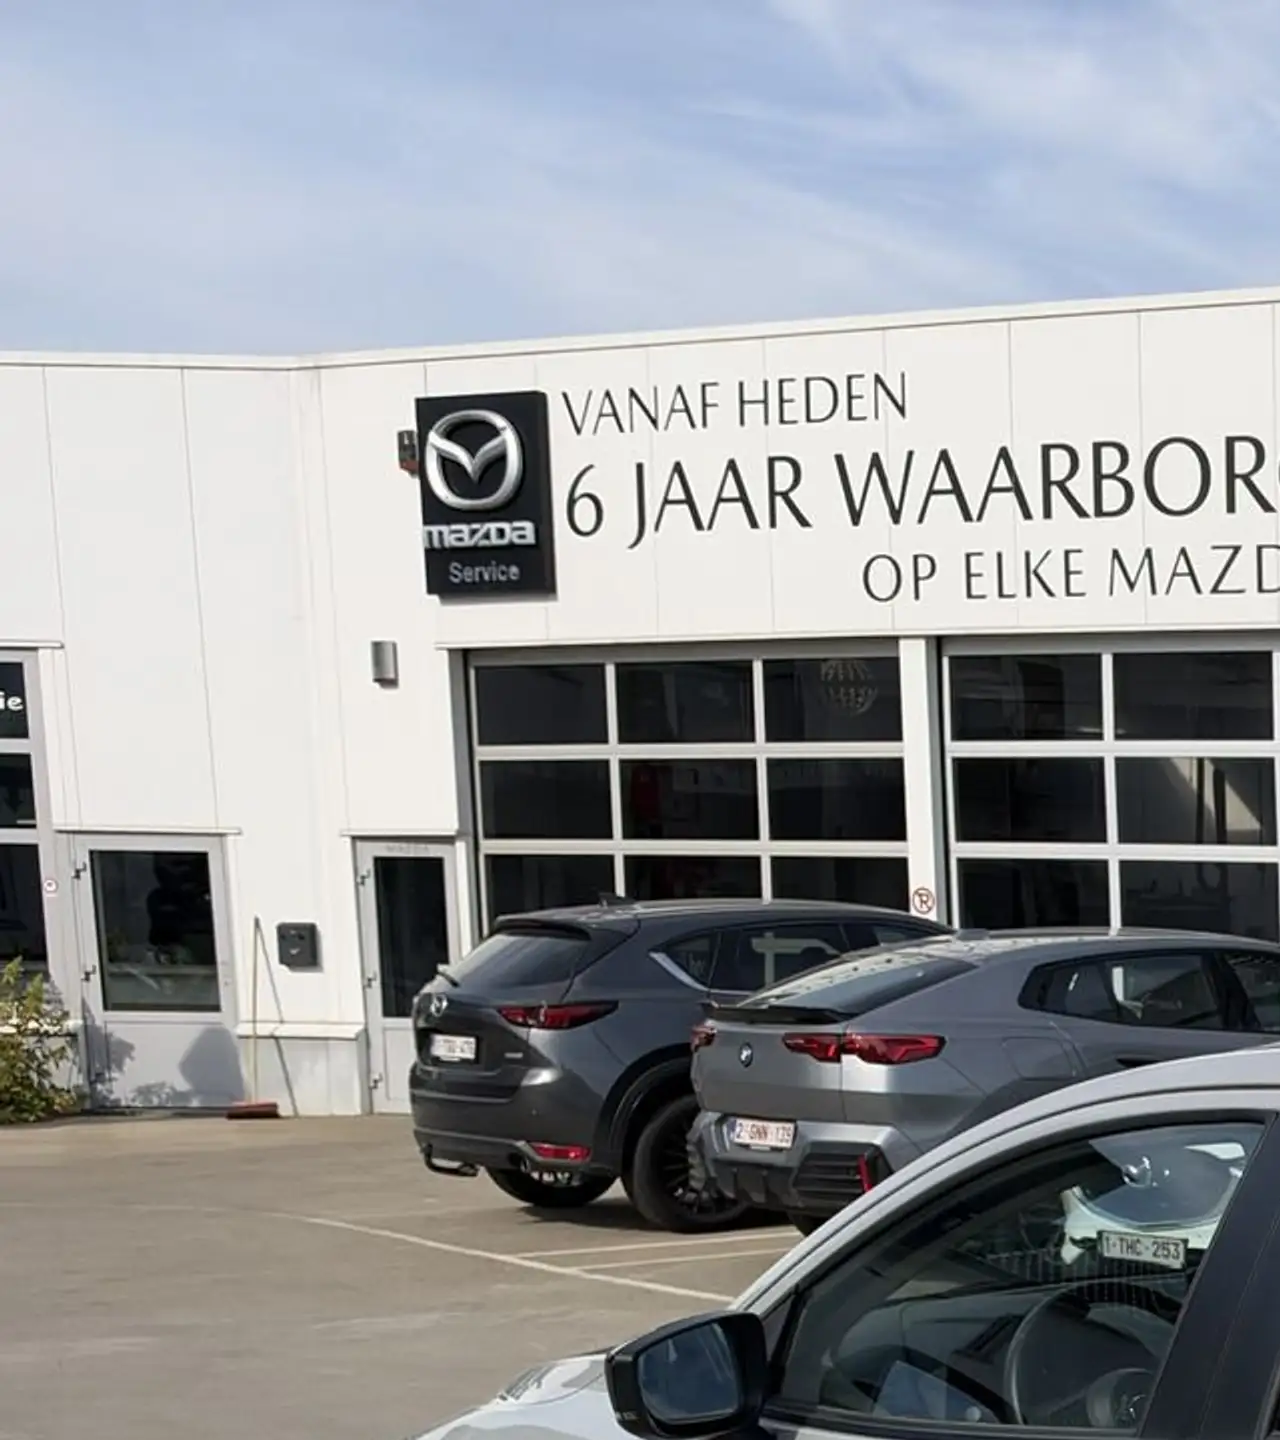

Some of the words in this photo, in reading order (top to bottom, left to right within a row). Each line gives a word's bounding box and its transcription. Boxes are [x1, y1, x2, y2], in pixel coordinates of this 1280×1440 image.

[562, 381, 719, 435] VANAF
[738, 373, 907, 427] HEDEN
[565, 464, 604, 537] 6
[628, 456, 812, 549] JAAR
[423, 520, 536, 549] mazda
[448, 560, 520, 584] Service
[863, 554, 937, 602] OP
[965, 549, 1086, 599] ELKE
[0, 691, 24, 712] ie
